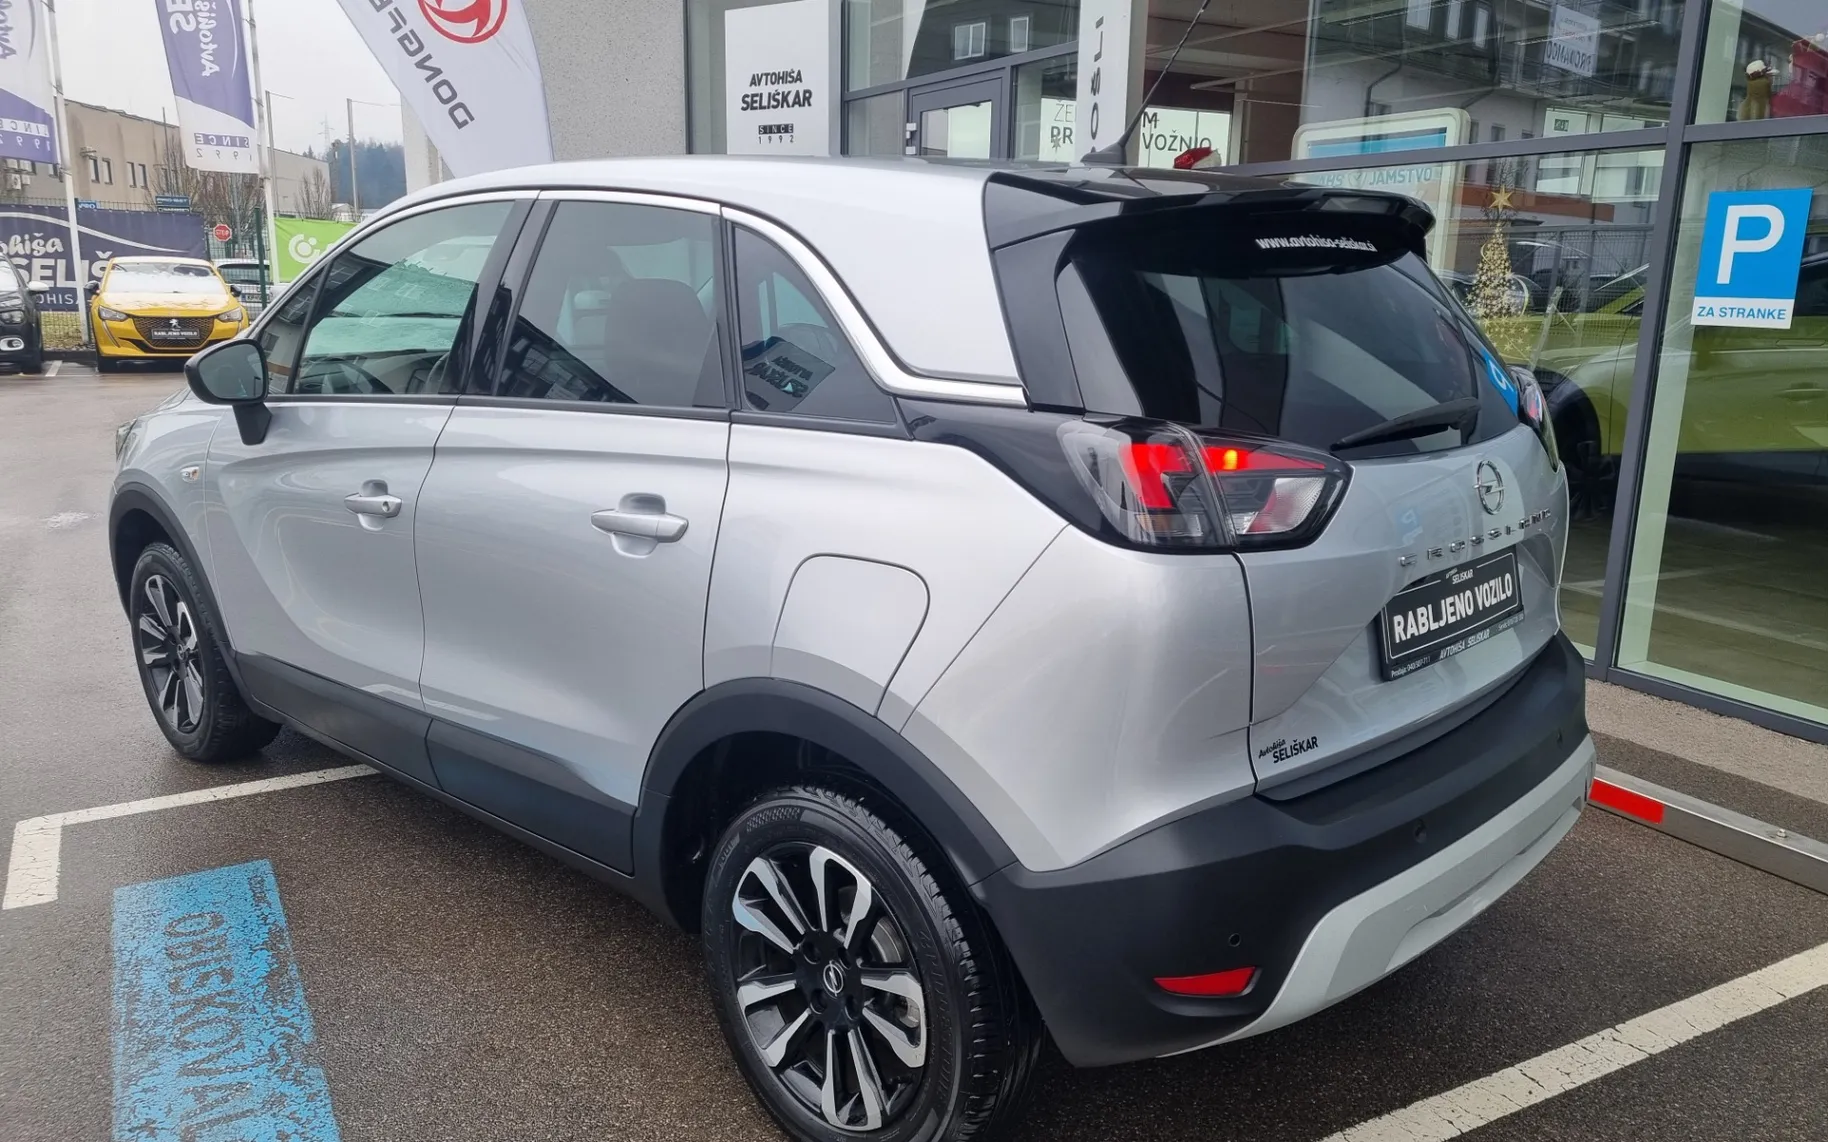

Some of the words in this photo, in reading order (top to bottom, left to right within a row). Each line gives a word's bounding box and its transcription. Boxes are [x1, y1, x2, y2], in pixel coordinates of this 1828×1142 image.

[749, 69, 803, 87] AVTOHIŠA
[741, 89, 812, 111] SELIŠKAR
[759, 124, 793, 134] SINCE
[759, 135, 794, 144] 1992
[1369, 168, 1433, 186] JAMSTVO
[1716, 204, 1785, 284] P
[1697, 306, 1715, 317] ZA
[1719, 306, 1786, 320] STRANKE
[1393, 589, 1475, 643] RABLJENO
[1475, 572, 1513, 611] VOZILO
[1272, 736, 1319, 763] SELIŠKAR
